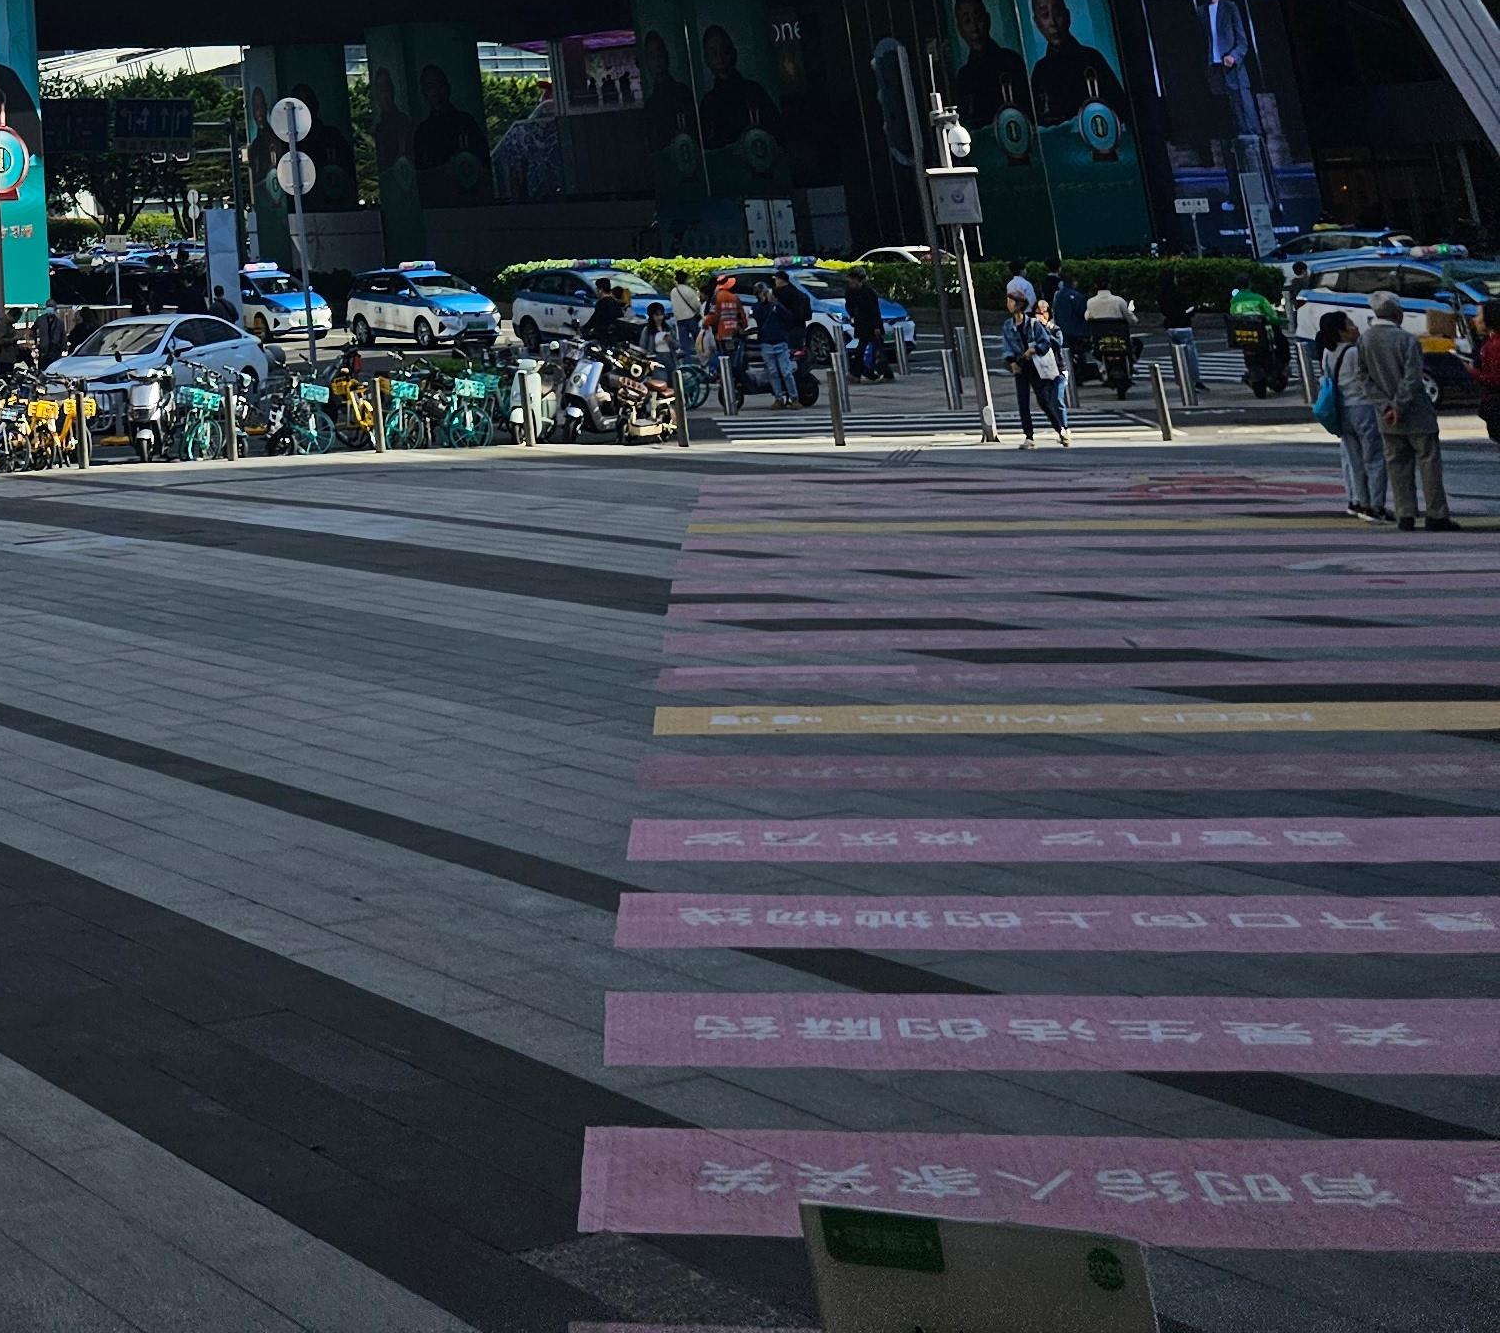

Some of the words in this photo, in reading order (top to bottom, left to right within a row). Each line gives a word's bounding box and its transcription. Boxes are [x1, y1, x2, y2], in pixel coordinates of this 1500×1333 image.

[696, 1158, 1404, 1210] 有时给人家笑笑
